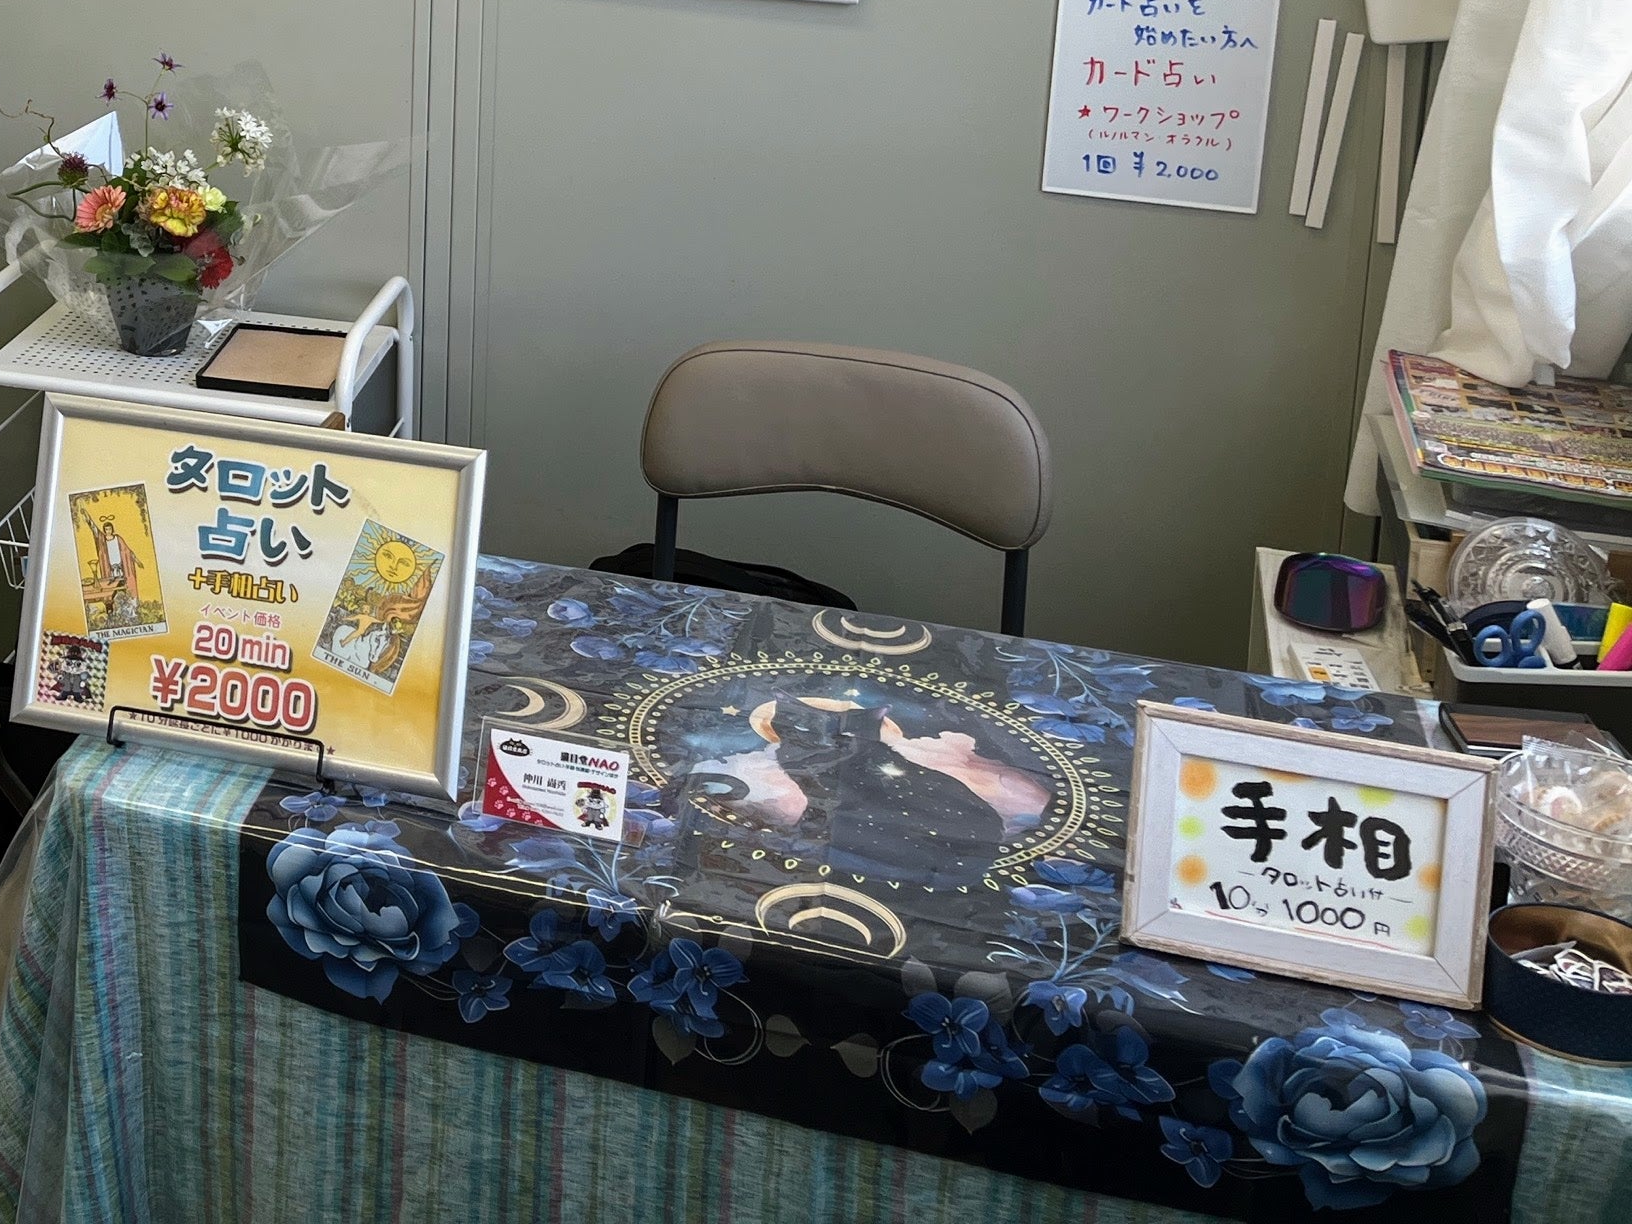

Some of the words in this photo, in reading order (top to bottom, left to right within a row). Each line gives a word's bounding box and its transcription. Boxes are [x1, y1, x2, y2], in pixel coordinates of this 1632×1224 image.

[1134, 24, 1258, 50] 始めたい方へ
[1083, 56, 1217, 88] カード占い
[1082, 153, 1117, 174] 1回
[166, 444, 350, 509] タロット
[197, 506, 313, 561] 占い
[112, 624, 154, 637] MAGICIAN
[200, 603, 281, 629] イベント価格
[194, 624, 234, 657] 20
[240, 635, 290, 667] min
[324, 651, 344, 668] THE
[151, 656, 313, 728] ¥2000
[1220, 780, 1412, 881] 手相
[1209, 880, 1269, 918] 10分
